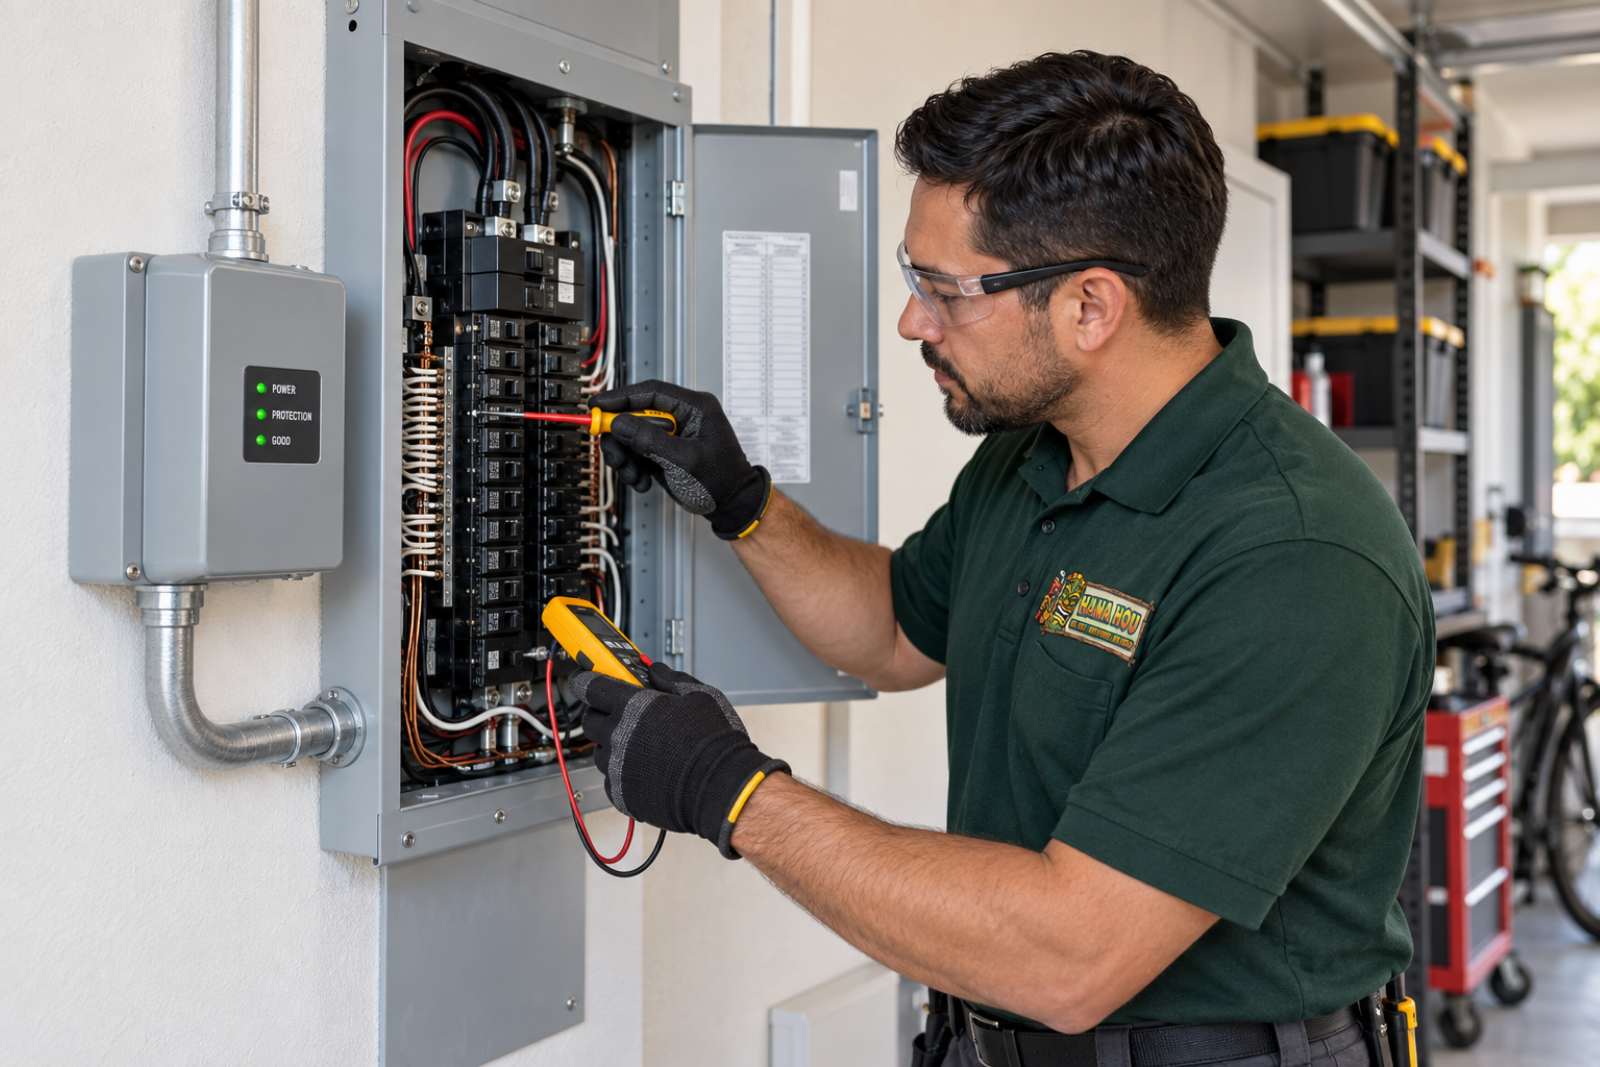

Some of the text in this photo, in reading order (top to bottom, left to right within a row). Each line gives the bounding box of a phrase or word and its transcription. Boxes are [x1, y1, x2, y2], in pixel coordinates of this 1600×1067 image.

[272, 384, 296, 394] POWER
[272, 410, 312, 421] PROTECTION
[272, 436, 291, 445] GOOD
[1112, 604, 1141, 634] HOU
